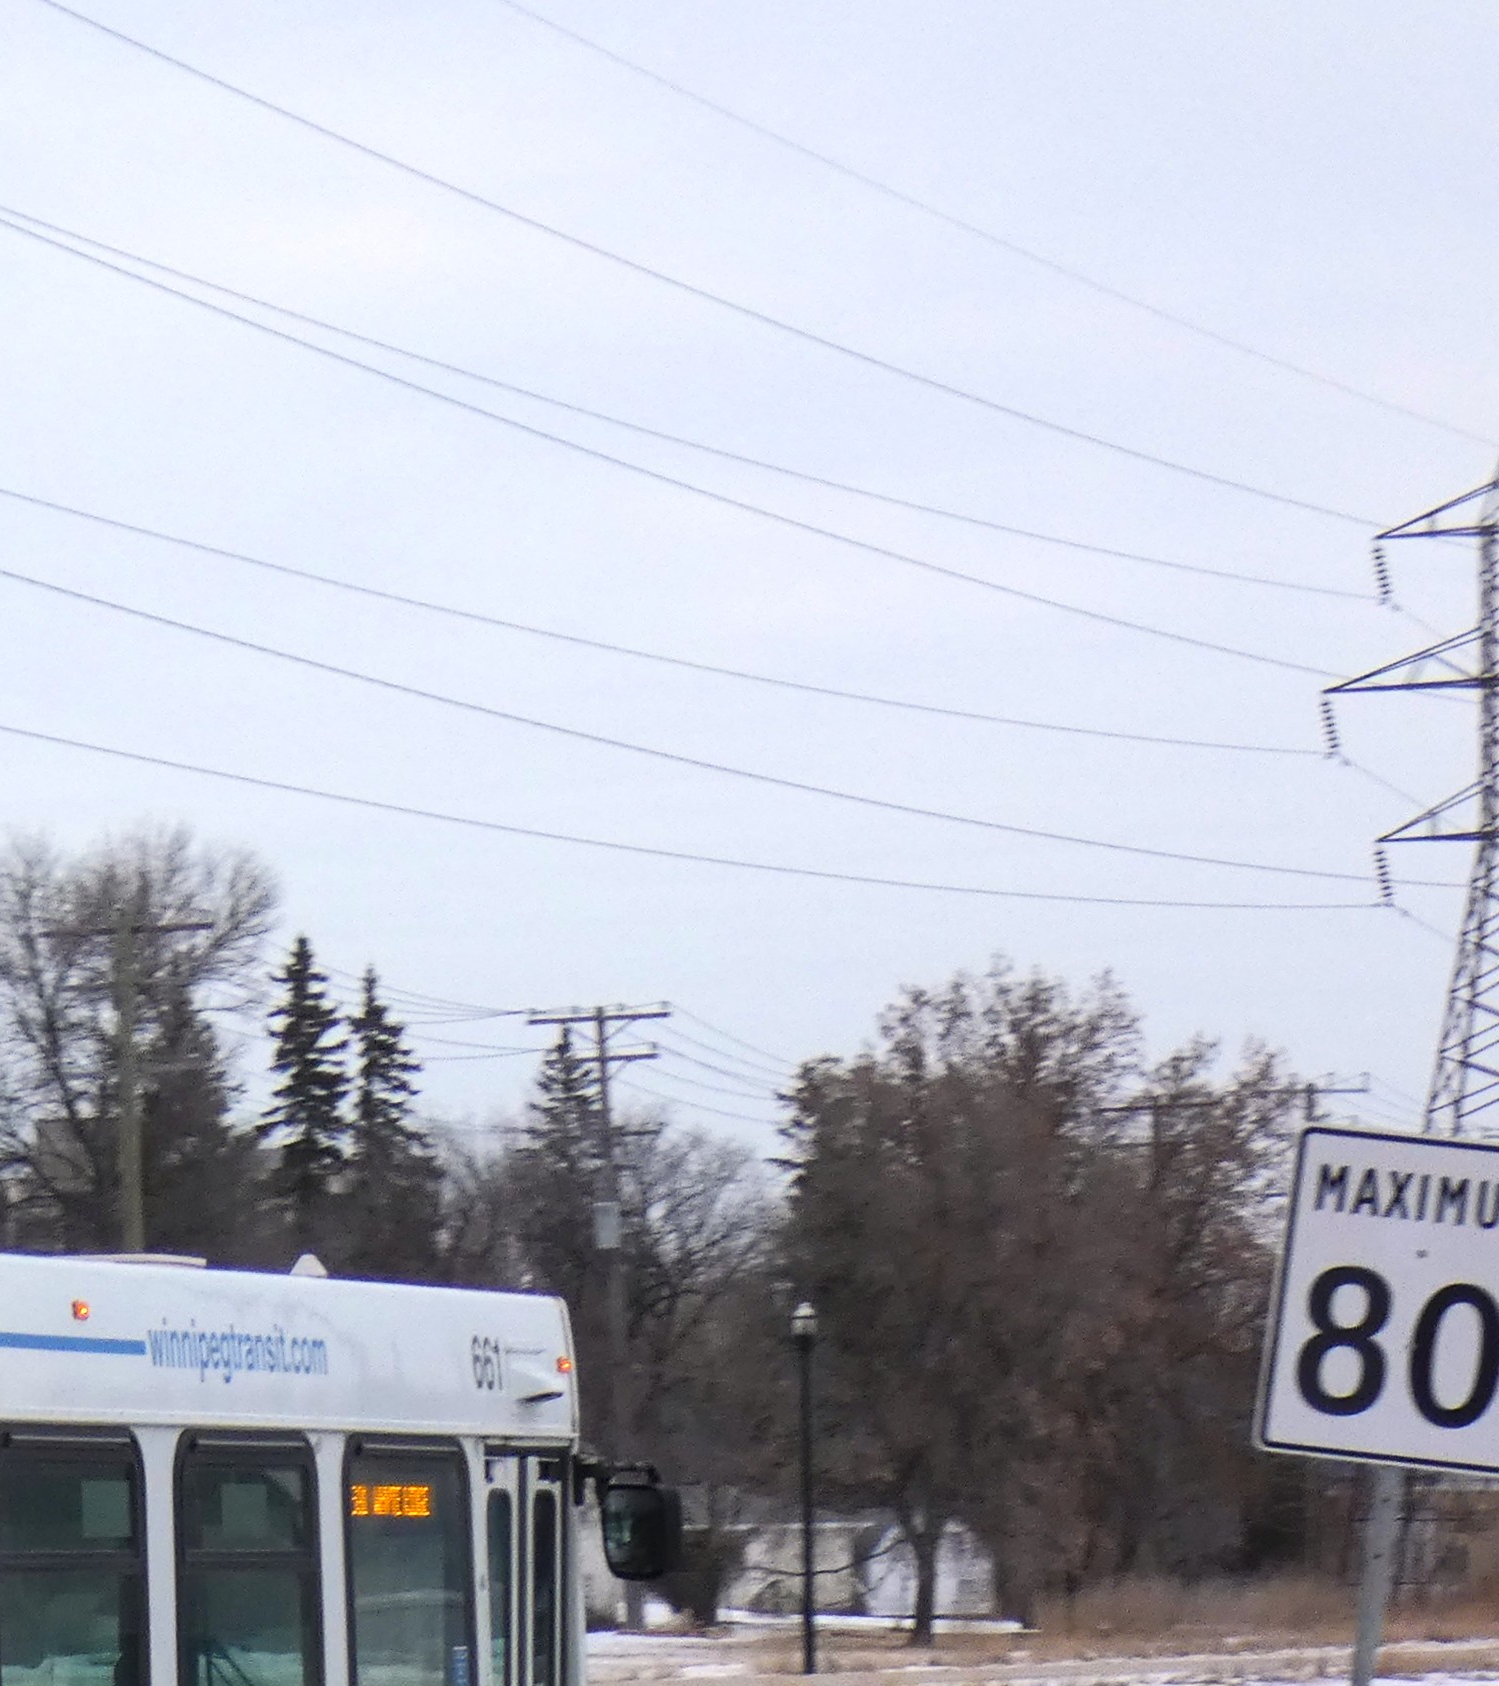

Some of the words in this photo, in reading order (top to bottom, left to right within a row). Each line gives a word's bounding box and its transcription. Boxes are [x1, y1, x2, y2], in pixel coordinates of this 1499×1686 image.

[148, 1317, 328, 1384] winnipegtransit.com
[471, 1335, 503, 1391] 661
[1297, 1265, 1499, 1429] 80
